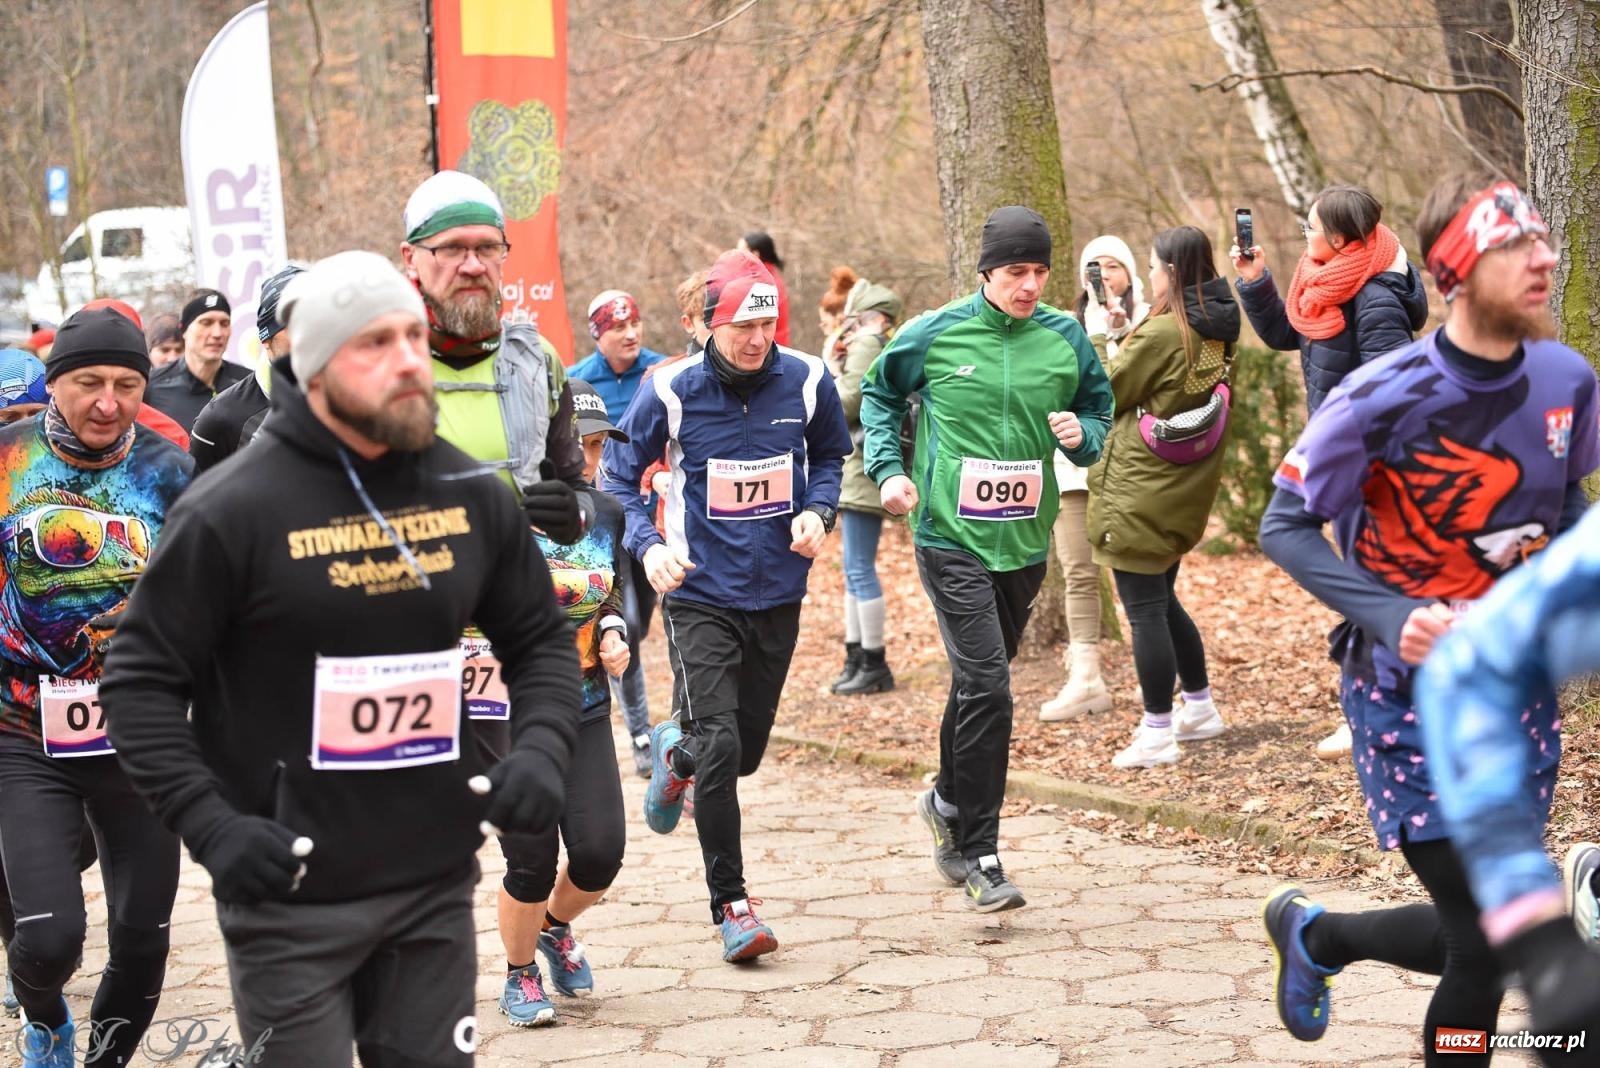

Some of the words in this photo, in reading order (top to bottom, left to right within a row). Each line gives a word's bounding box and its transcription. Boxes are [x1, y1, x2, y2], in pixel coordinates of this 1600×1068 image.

[734, 480, 769, 503] 171
[976, 480, 1027, 503] 090
[351, 693, 432, 734] 072
